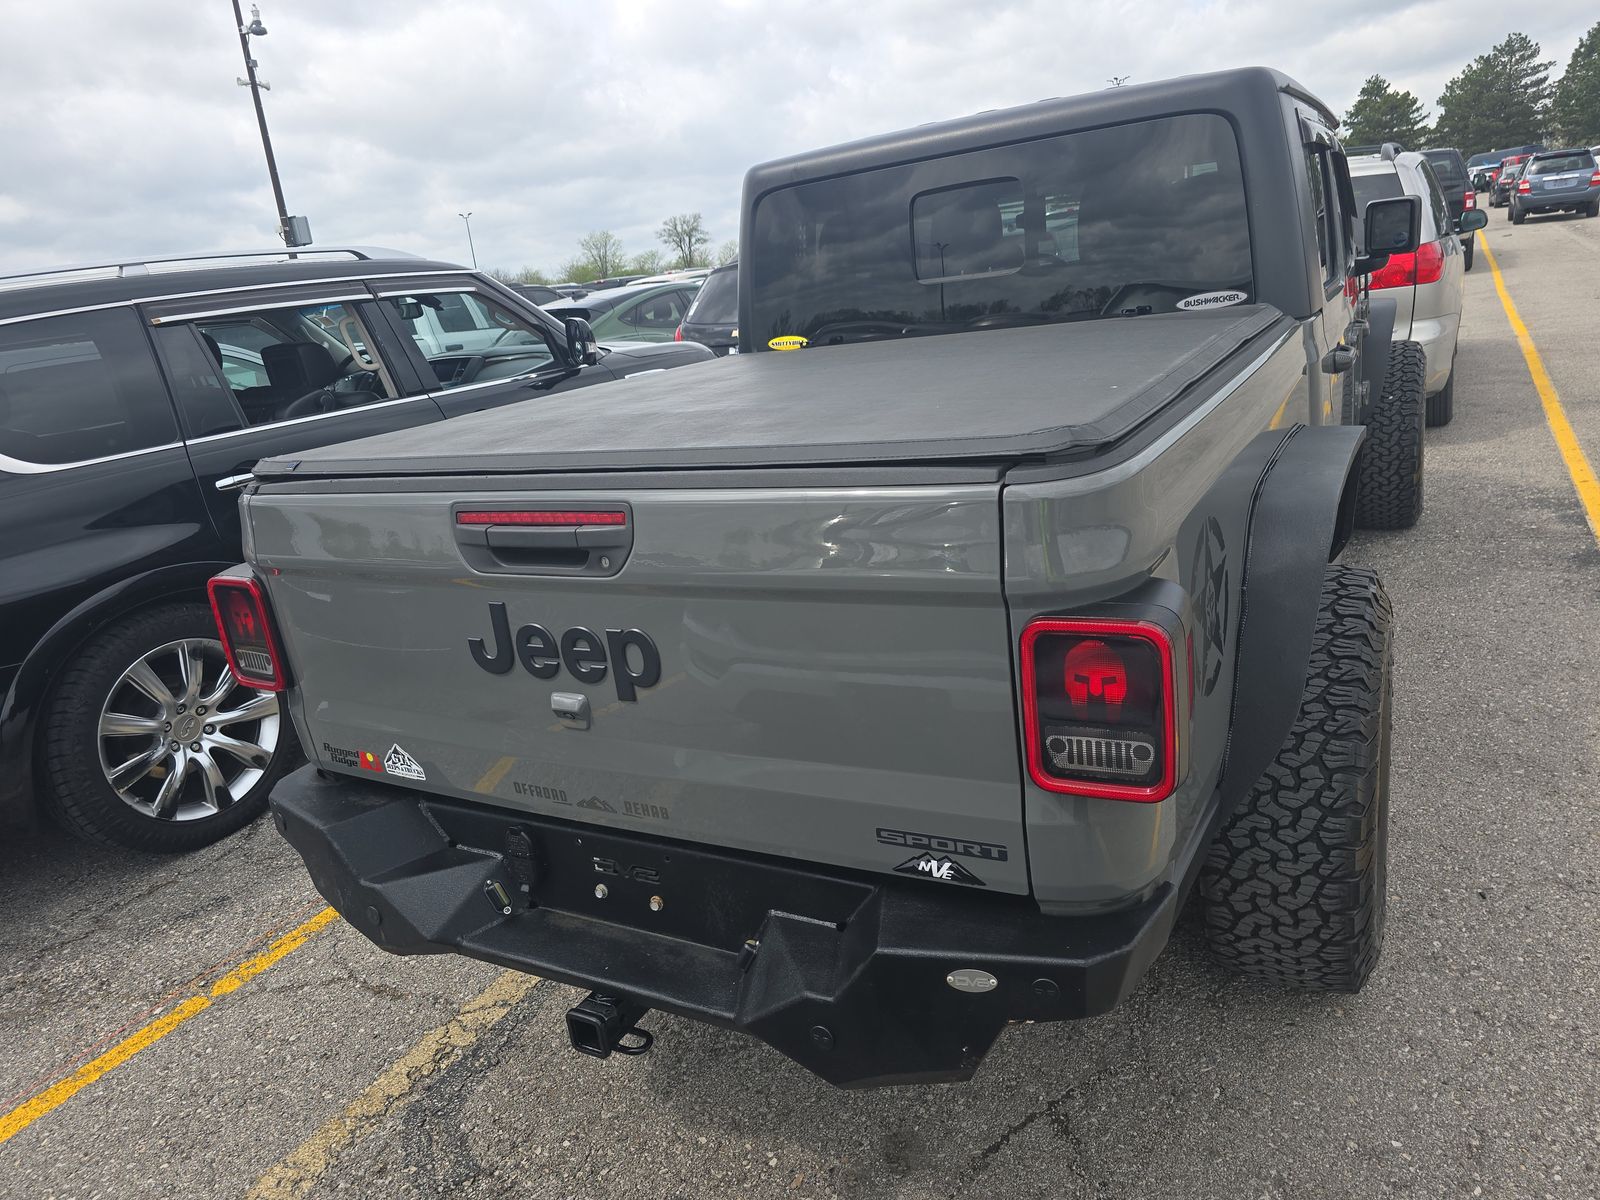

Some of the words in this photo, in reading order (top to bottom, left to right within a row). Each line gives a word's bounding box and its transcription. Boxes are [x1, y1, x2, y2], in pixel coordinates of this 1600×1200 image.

[1183, 293, 1240, 308] BUSHWACKER
[771, 340, 804, 348] SMITTYBIL
[467, 601, 661, 702] Jeep
[323, 743, 360, 759] Rugged
[331, 752, 358, 767] Ridge
[513, 782, 568, 801] OFFROAD
[624, 801, 670, 820] REHAB
[877, 829, 1007, 860] SPORT
